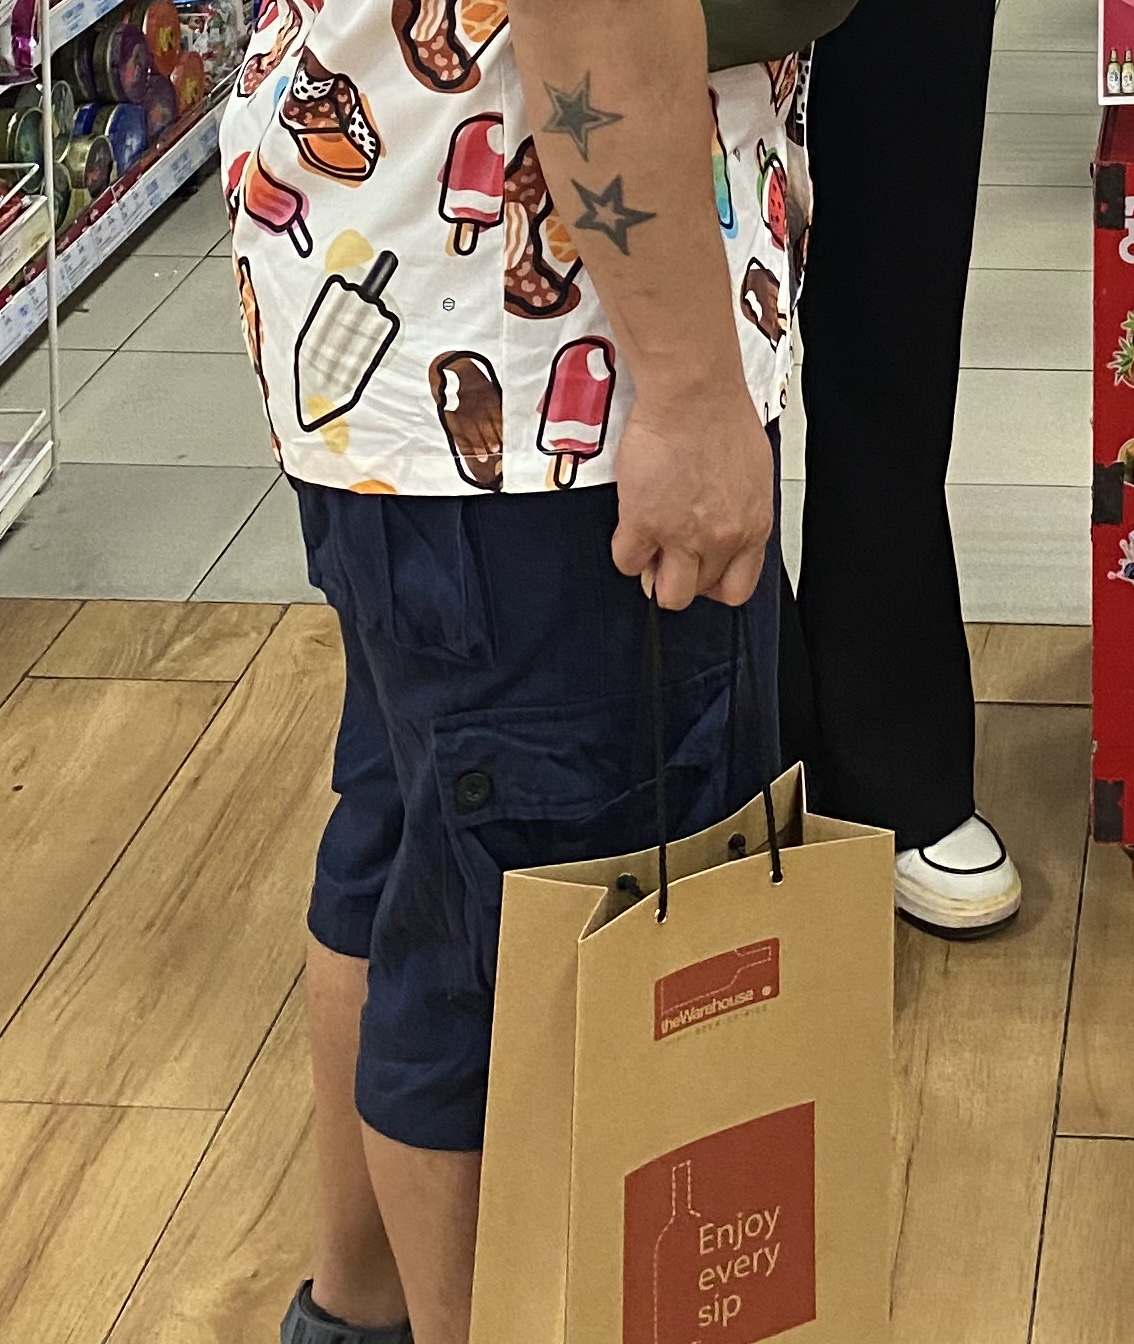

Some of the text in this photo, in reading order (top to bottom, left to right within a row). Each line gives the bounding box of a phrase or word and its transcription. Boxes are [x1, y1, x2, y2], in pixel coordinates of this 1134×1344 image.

[698, 1205, 781, 1255] Enjoy
[698, 1241, 781, 1291] every
[698, 1293, 742, 1328] sip
